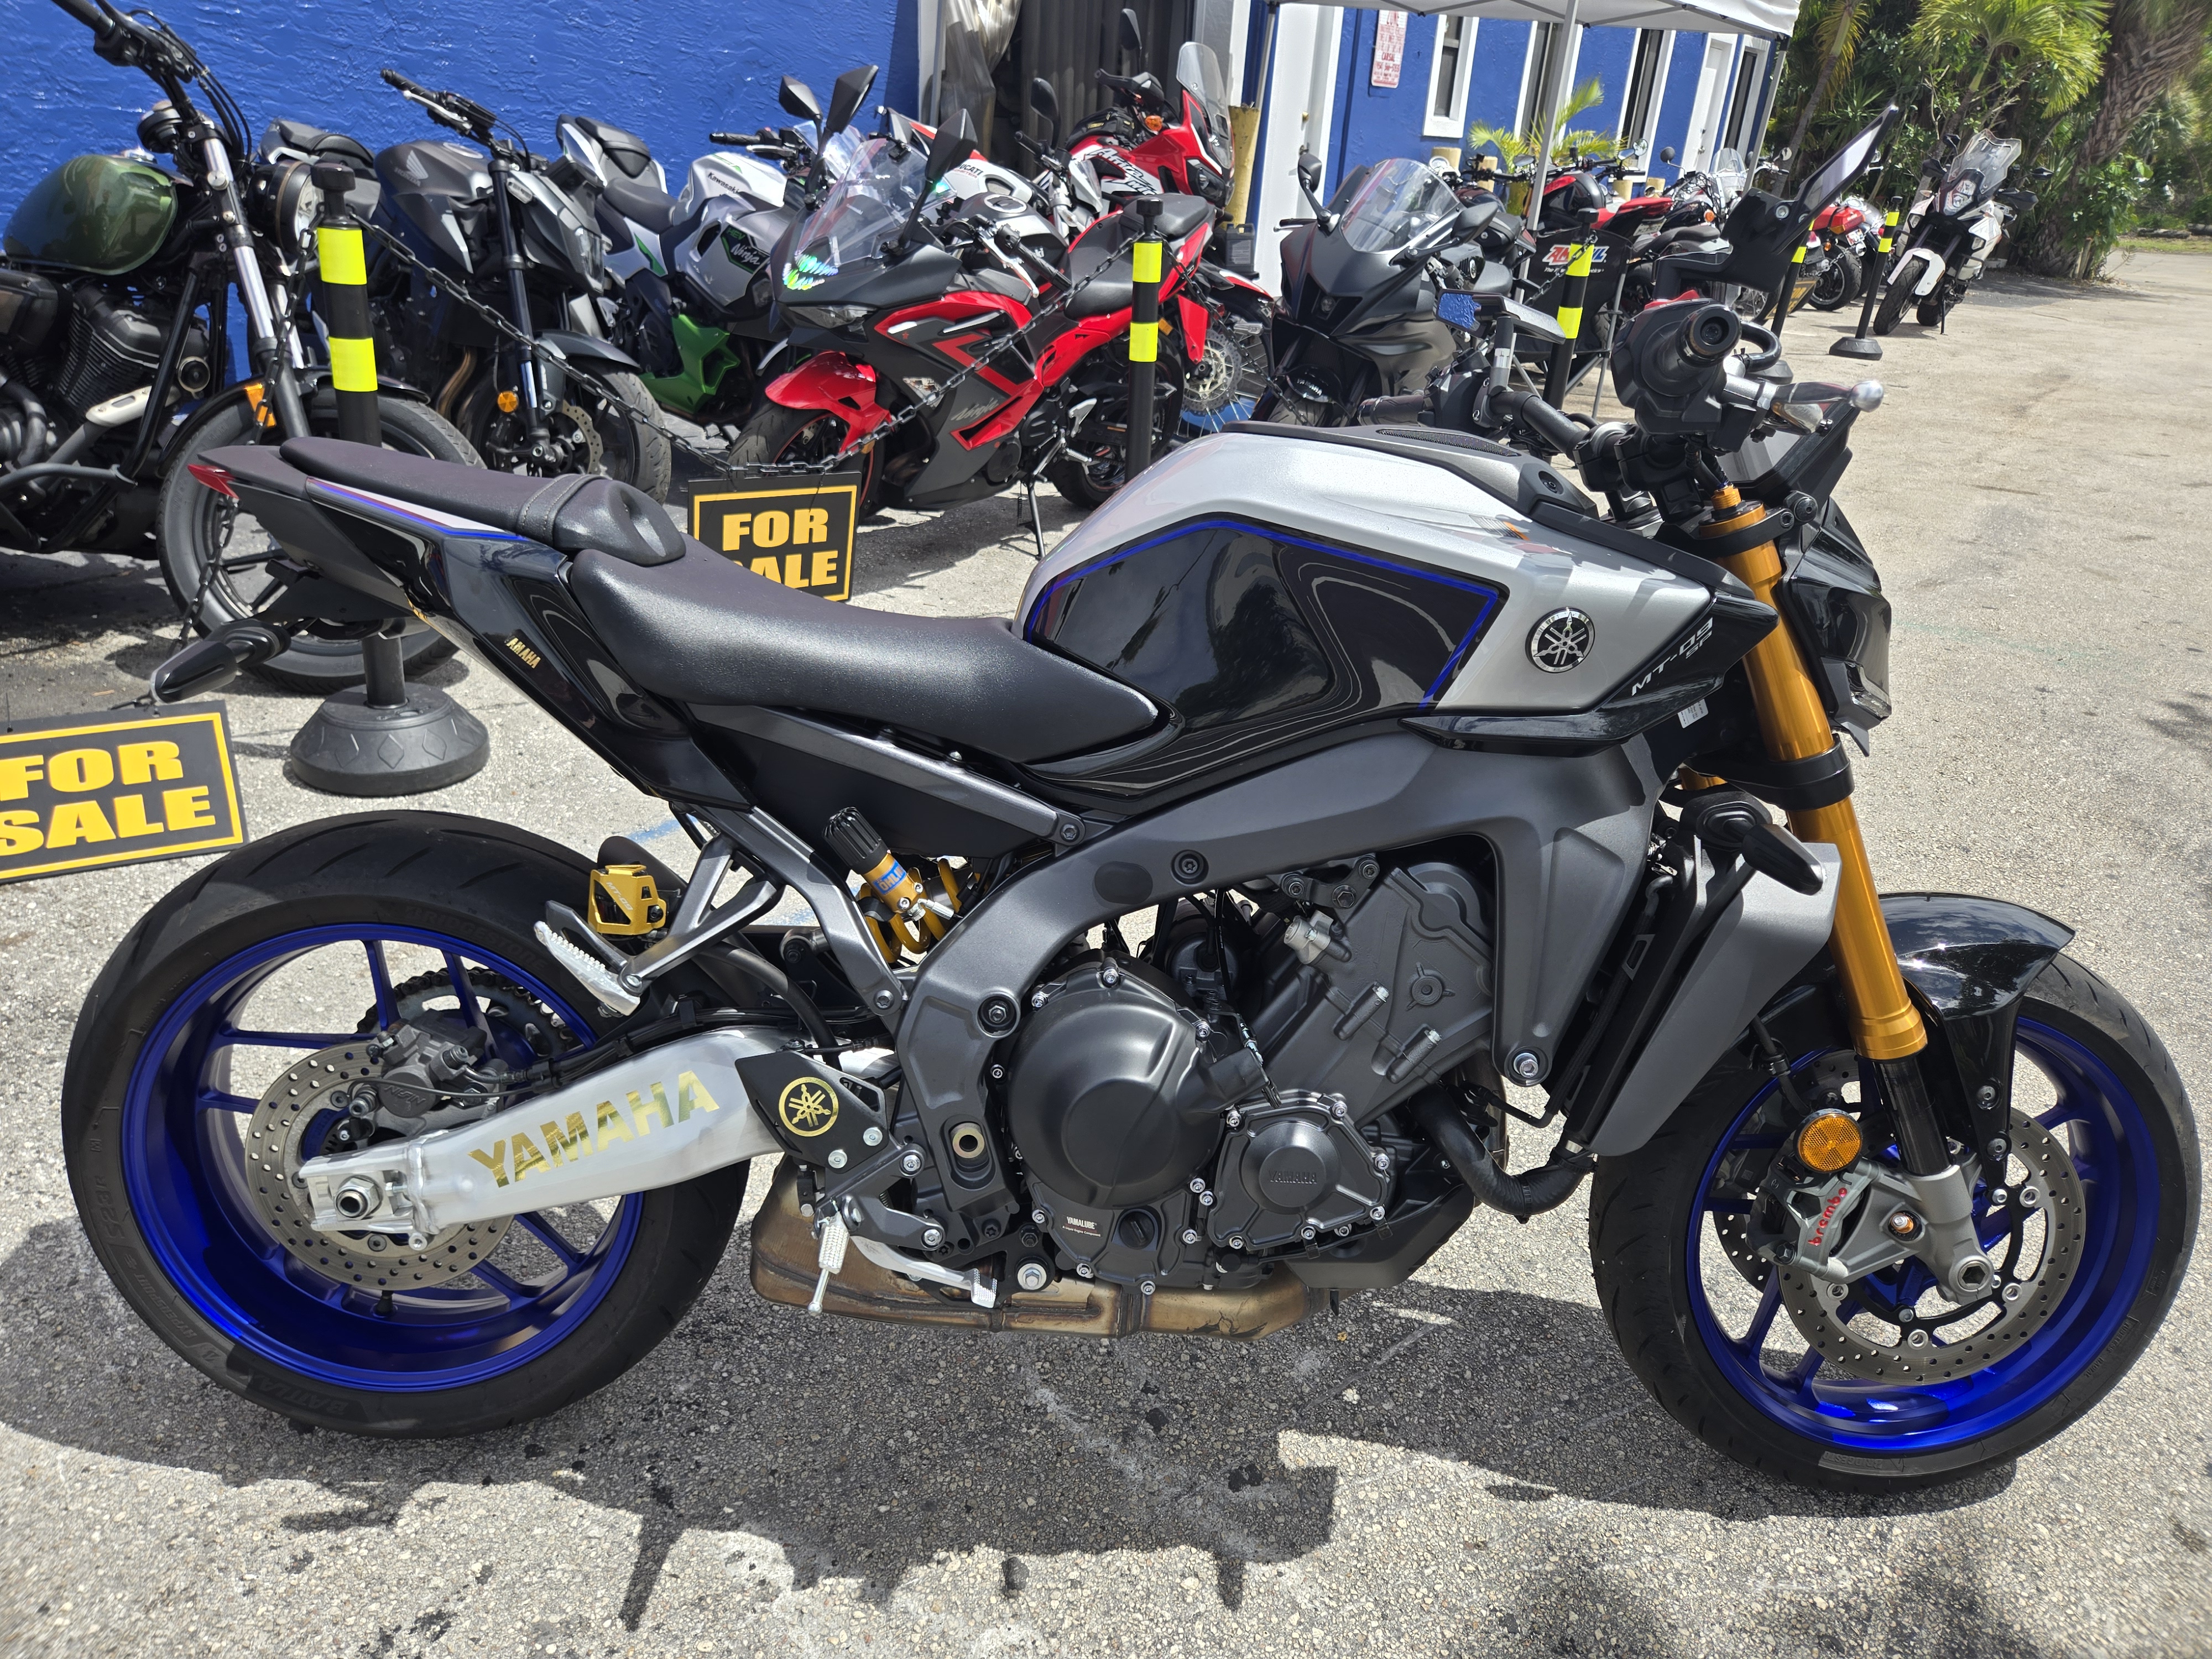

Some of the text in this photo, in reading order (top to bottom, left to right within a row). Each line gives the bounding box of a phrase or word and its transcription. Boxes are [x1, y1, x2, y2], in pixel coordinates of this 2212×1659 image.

[708, 172, 740, 194] Kawasaki
[959, 164, 984, 176] UCATI
[731, 243, 760, 265] Ninja
[1545, 246, 1608, 264] AMIL
[723, 508, 828, 551] FOR
[733, 550, 838, 589] ALE
[1632, 617, 1713, 696] MT-09
[1686, 630, 1712, 659] SP
[0, 740, 184, 801] FOR
[0, 785, 216, 857] SALE
[606, 882, 634, 910] MT-09
[467, 1070, 720, 1188] YAMAHA
[1269, 1171, 1317, 1184] YAMAHA
[1066, 1217, 1095, 1229] YAMALUBE
[1807, 1187, 1848, 1246] brembo
[134, 1272, 197, 1339] HYPERSPORT
